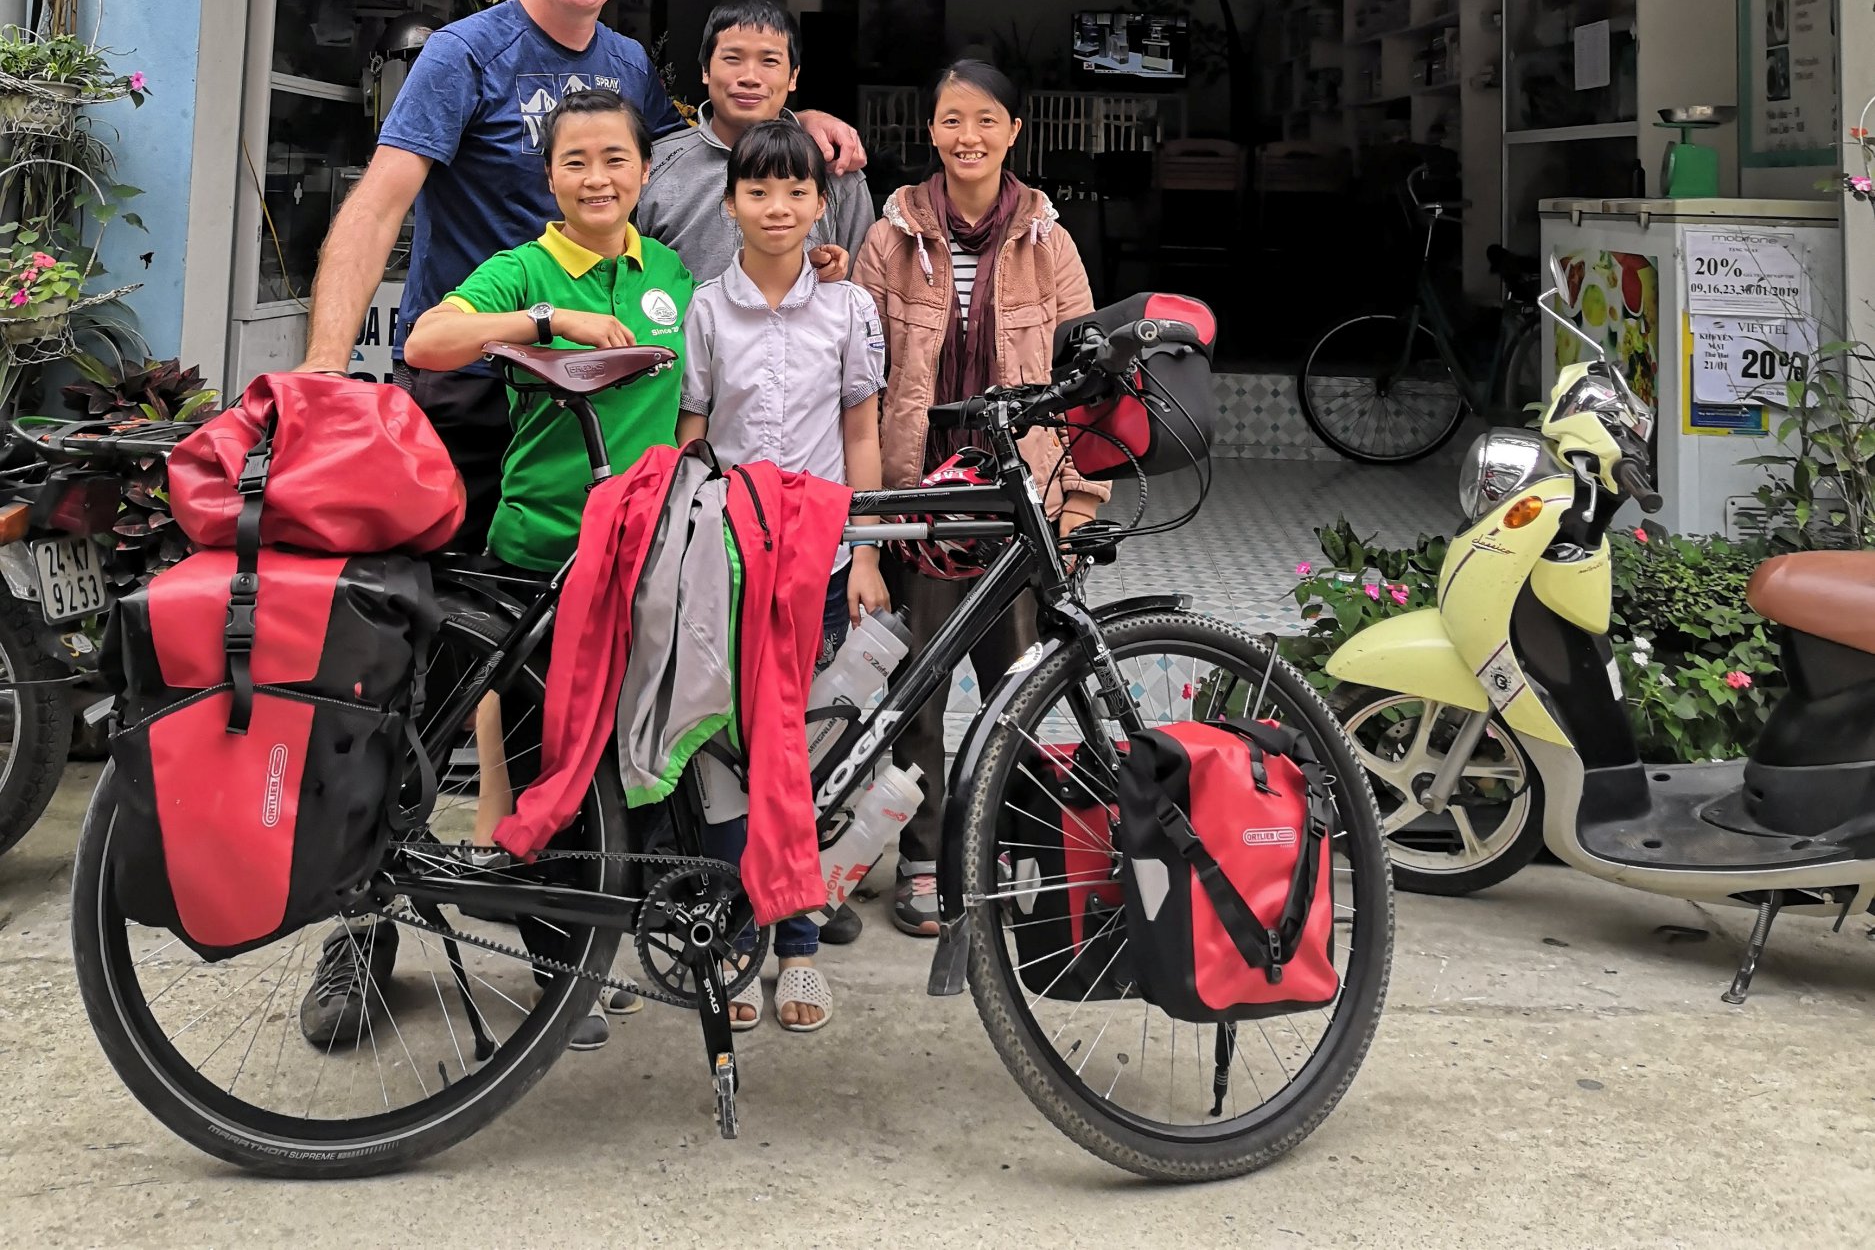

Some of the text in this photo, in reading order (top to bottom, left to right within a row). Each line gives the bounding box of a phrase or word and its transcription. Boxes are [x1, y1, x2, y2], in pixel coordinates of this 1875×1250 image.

[595, 76, 619, 89] SPRAY
[1694, 257, 1743, 278] 20%
[1738, 322, 1790, 335] VIETTEL
[1741, 349, 1805, 382] 20%
[53, 575, 100, 615] 9253
[267, 781, 279, 821] ORTLIEB
[1247, 832, 1275, 841] ORTLIEB
[207, 1124, 336, 1161] MARATHON SUPREME
